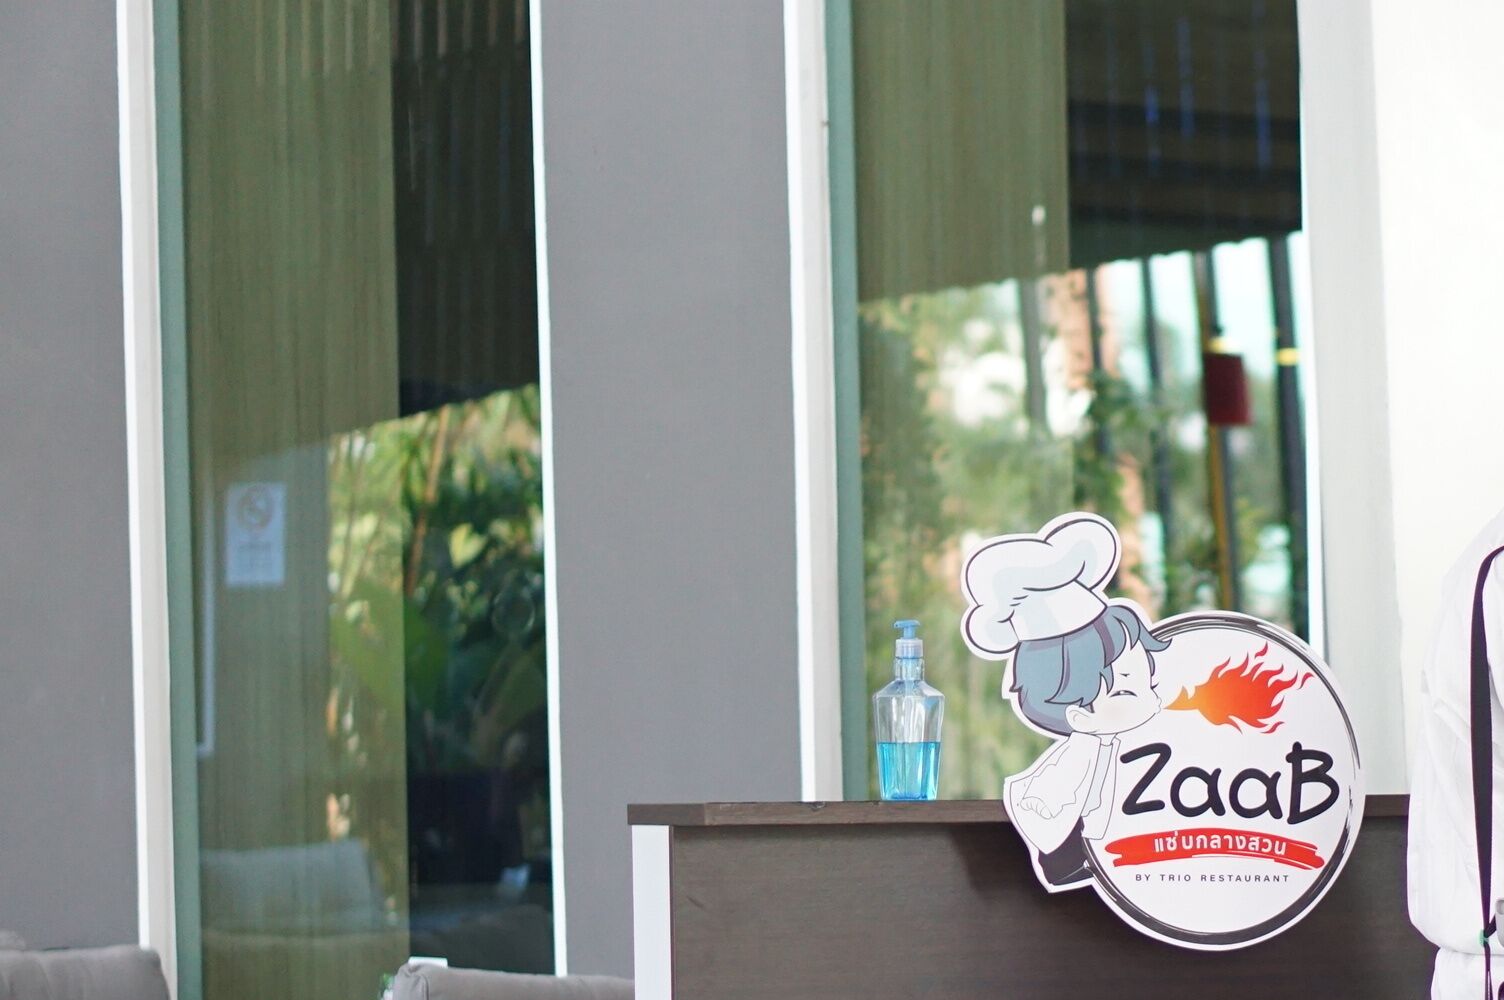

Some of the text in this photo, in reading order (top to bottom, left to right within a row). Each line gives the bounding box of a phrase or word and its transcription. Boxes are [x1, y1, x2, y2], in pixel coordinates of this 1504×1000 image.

[1119, 741, 1340, 825] ZaaB
[1154, 831, 1286, 855] แซ่บกลางสวน
[1135, 873, 1290, 882] BY TRIO RESTAURANT
